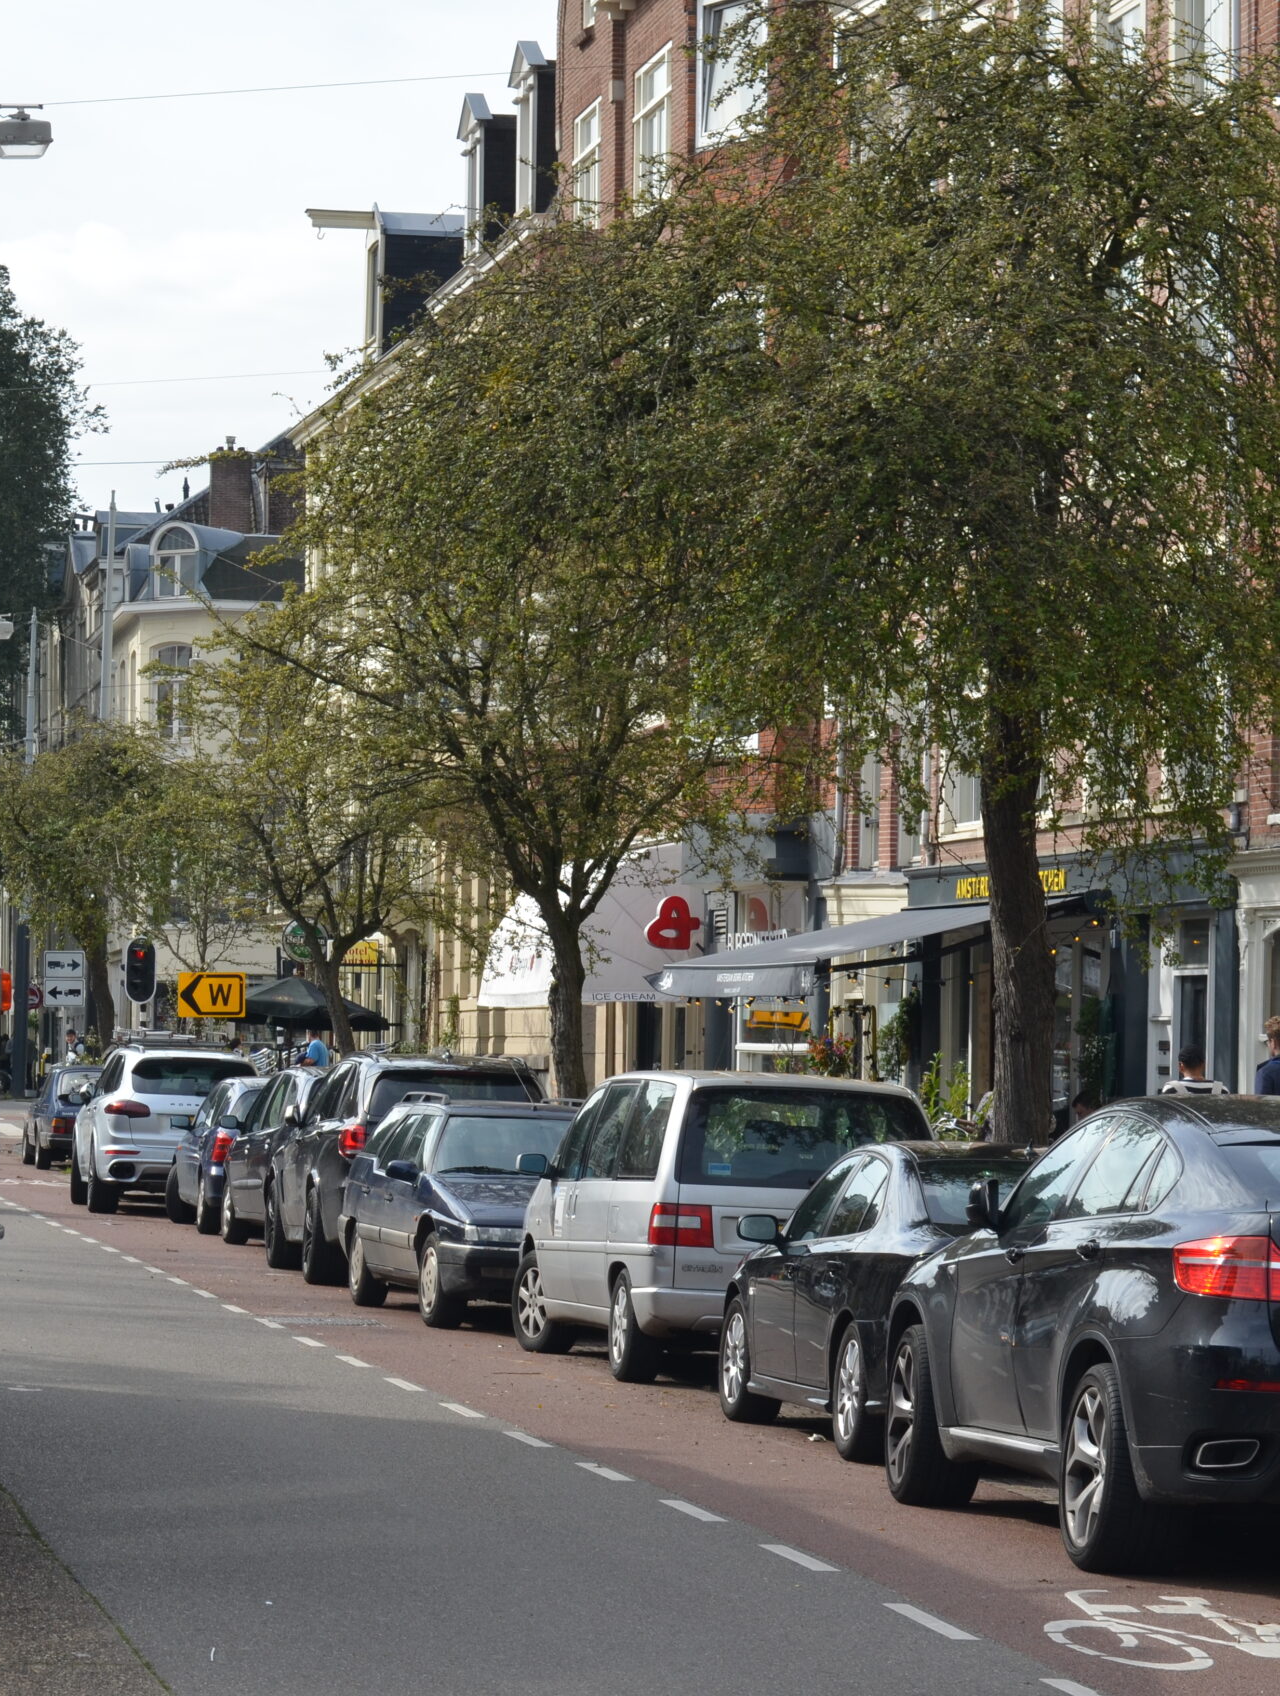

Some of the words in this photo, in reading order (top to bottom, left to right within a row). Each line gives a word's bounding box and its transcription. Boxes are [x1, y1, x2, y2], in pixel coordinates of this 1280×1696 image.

[956, 876, 990, 899] AMSTERD
[1038, 868, 1066, 893] TCHEN
[345, 946, 368, 955] otel
[208, 983, 233, 1007] W
[592, 993, 611, 1001] ICE
[614, 993, 656, 1001] CREAM
